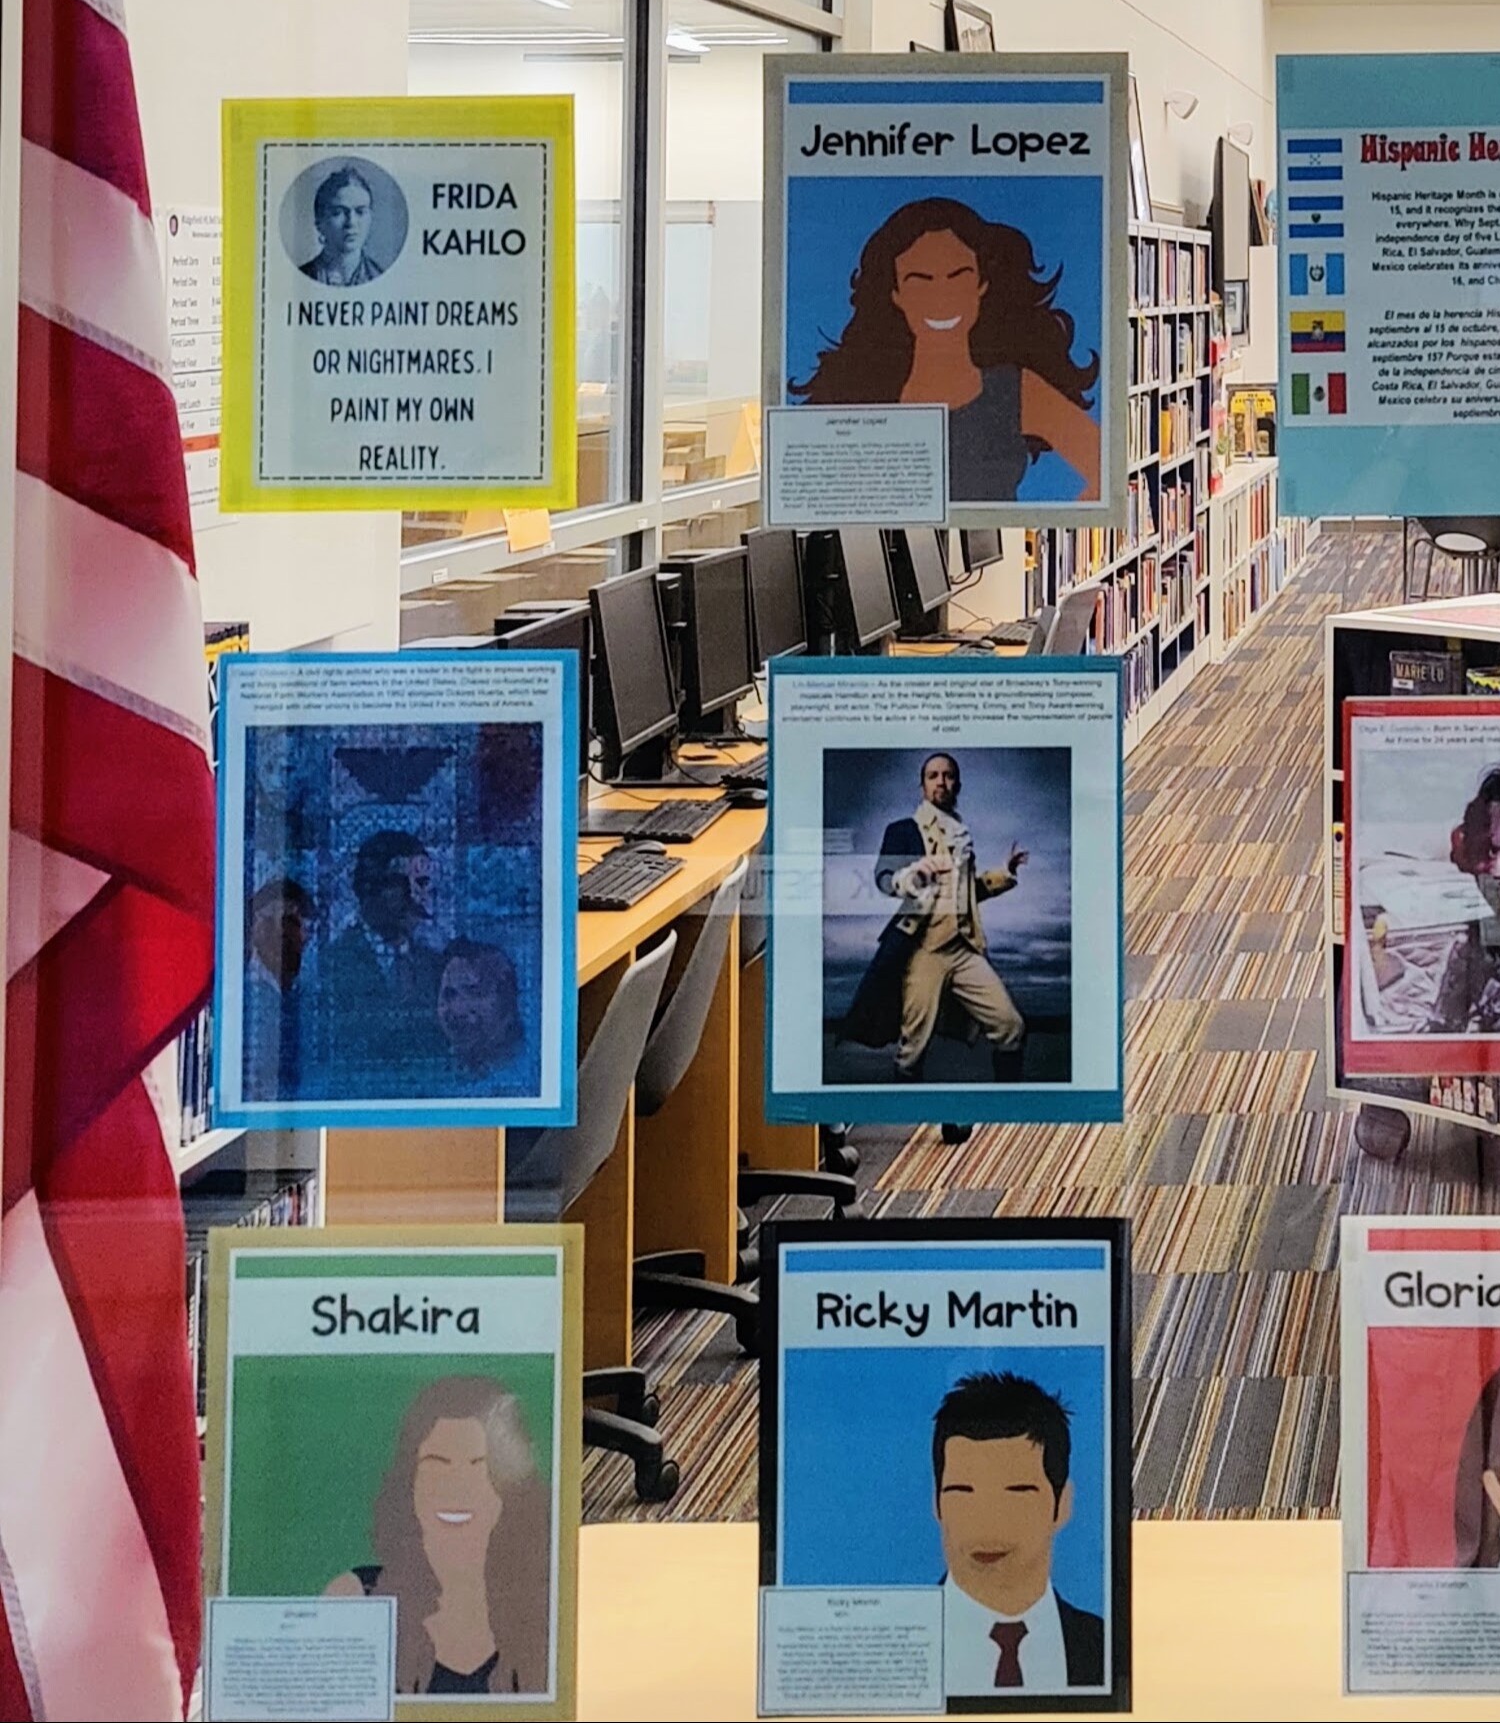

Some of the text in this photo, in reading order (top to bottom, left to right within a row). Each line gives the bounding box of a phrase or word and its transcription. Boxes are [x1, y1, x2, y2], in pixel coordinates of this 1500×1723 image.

[800, 122, 1090, 162] Jennifer Lopez
[1360, 132, 1460, 171] Hispanic
[433, 183, 517, 209] FRIDA
[423, 229, 526, 256] KAHLO
[287, 301, 518, 326] I NEVER PAINT DREAMS
[313, 349, 492, 374] OR NIGHTMARES. I
[331, 397, 474, 422] PAINT MY OWN
[359, 445, 445, 471] REALITY.
[1395, 662, 1444, 683] MARIE LU
[312, 1293, 479, 1336] Shakira
[817, 1289, 1077, 1338] Ricky Martin
